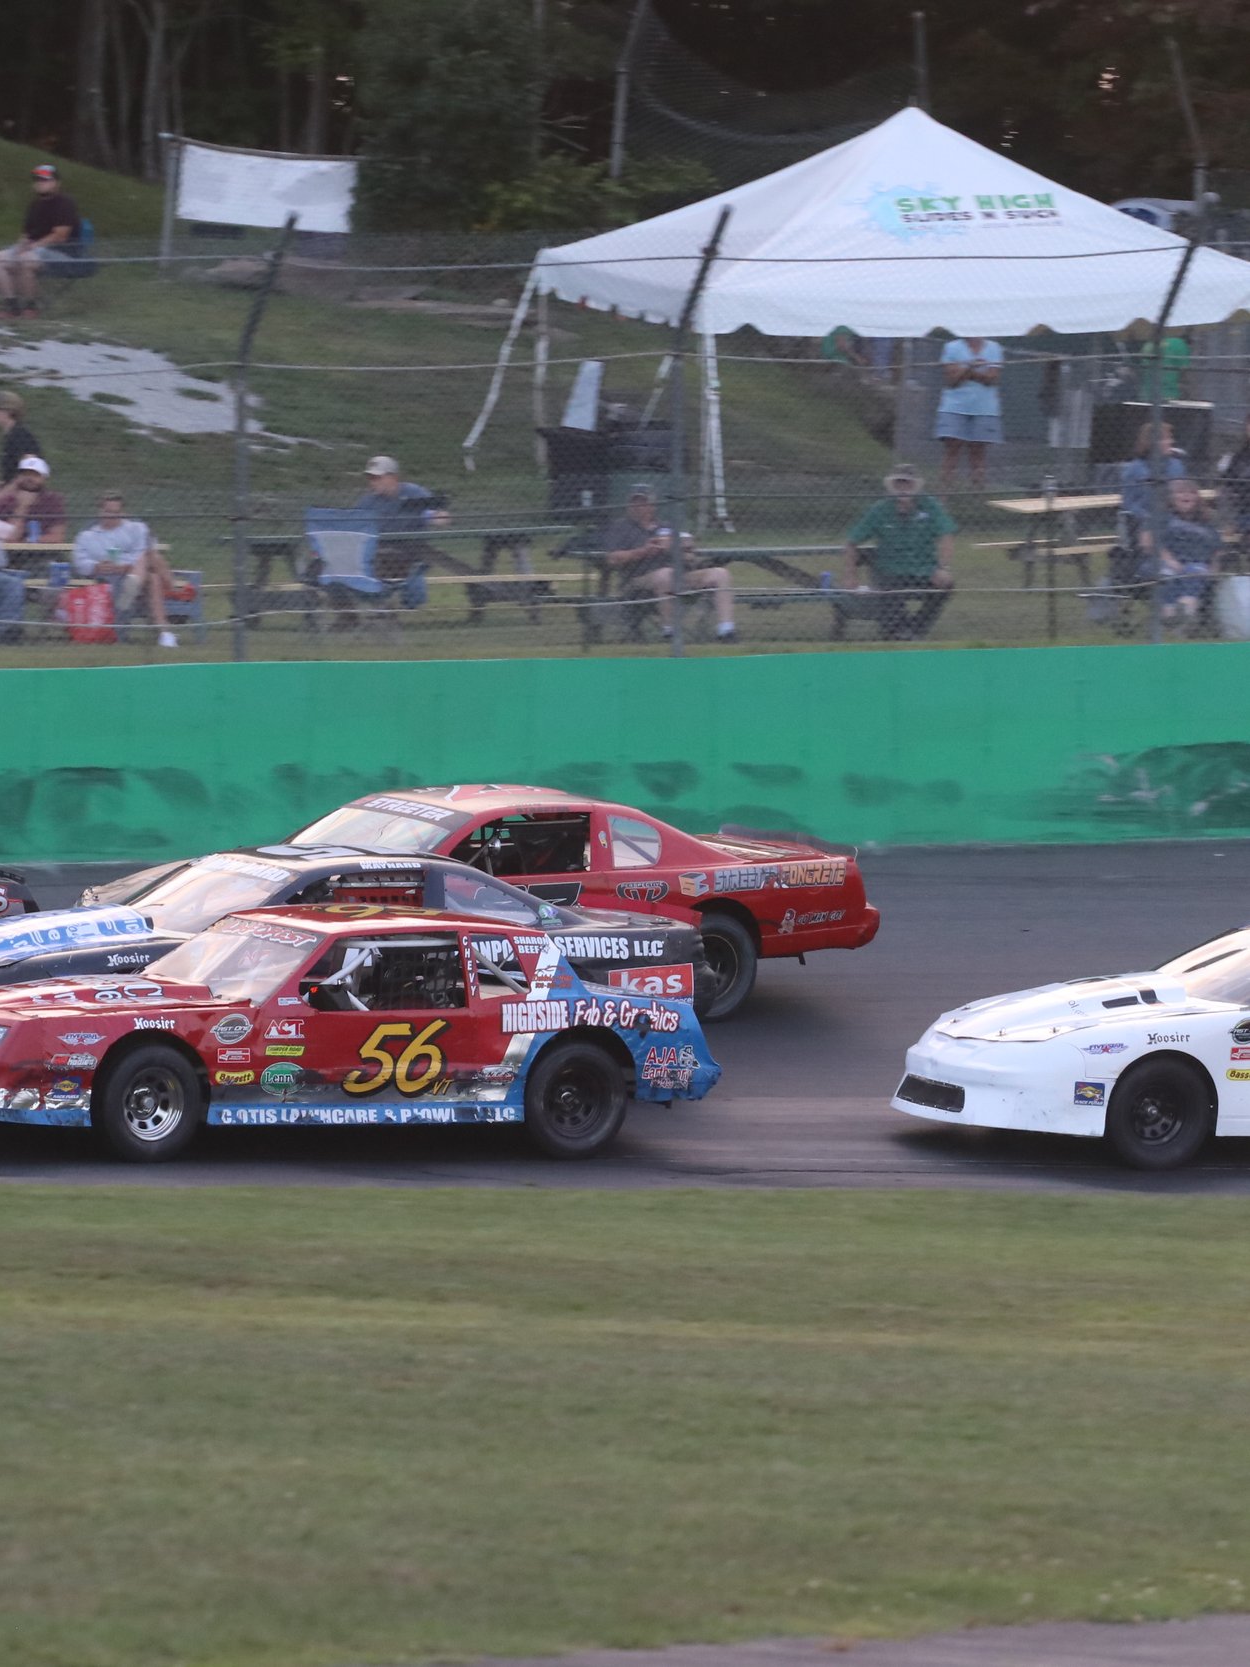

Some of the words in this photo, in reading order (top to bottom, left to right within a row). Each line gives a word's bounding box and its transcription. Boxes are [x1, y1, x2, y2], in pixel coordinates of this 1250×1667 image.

[897, 195, 960, 213] SKY
[974, 193, 1055, 210] HIGH
[364, 797, 454, 821] STREETER
[781, 862, 846, 888] CONCRETE
[513, 936, 549, 945] SHARON
[554, 936, 629, 959] SERVICES
[107, 953, 150, 967] Hoosier
[462, 936, 477, 996] CHEVY
[620, 971, 683, 994] kas
[134, 1016, 176, 1030] Hoosier
[502, 1001, 569, 1033] HIGHSIDE
[603, 1001, 618, 1027] &
[620, 1000, 679, 1032] Grphics
[264, 1019, 305, 1039] ACT
[1146, 1032, 1191, 1045] Hoosier
[342, 1018, 447, 1094] 56
[432, 1079, 454, 1095] VT
[646, 1046, 678, 1066] AJA
